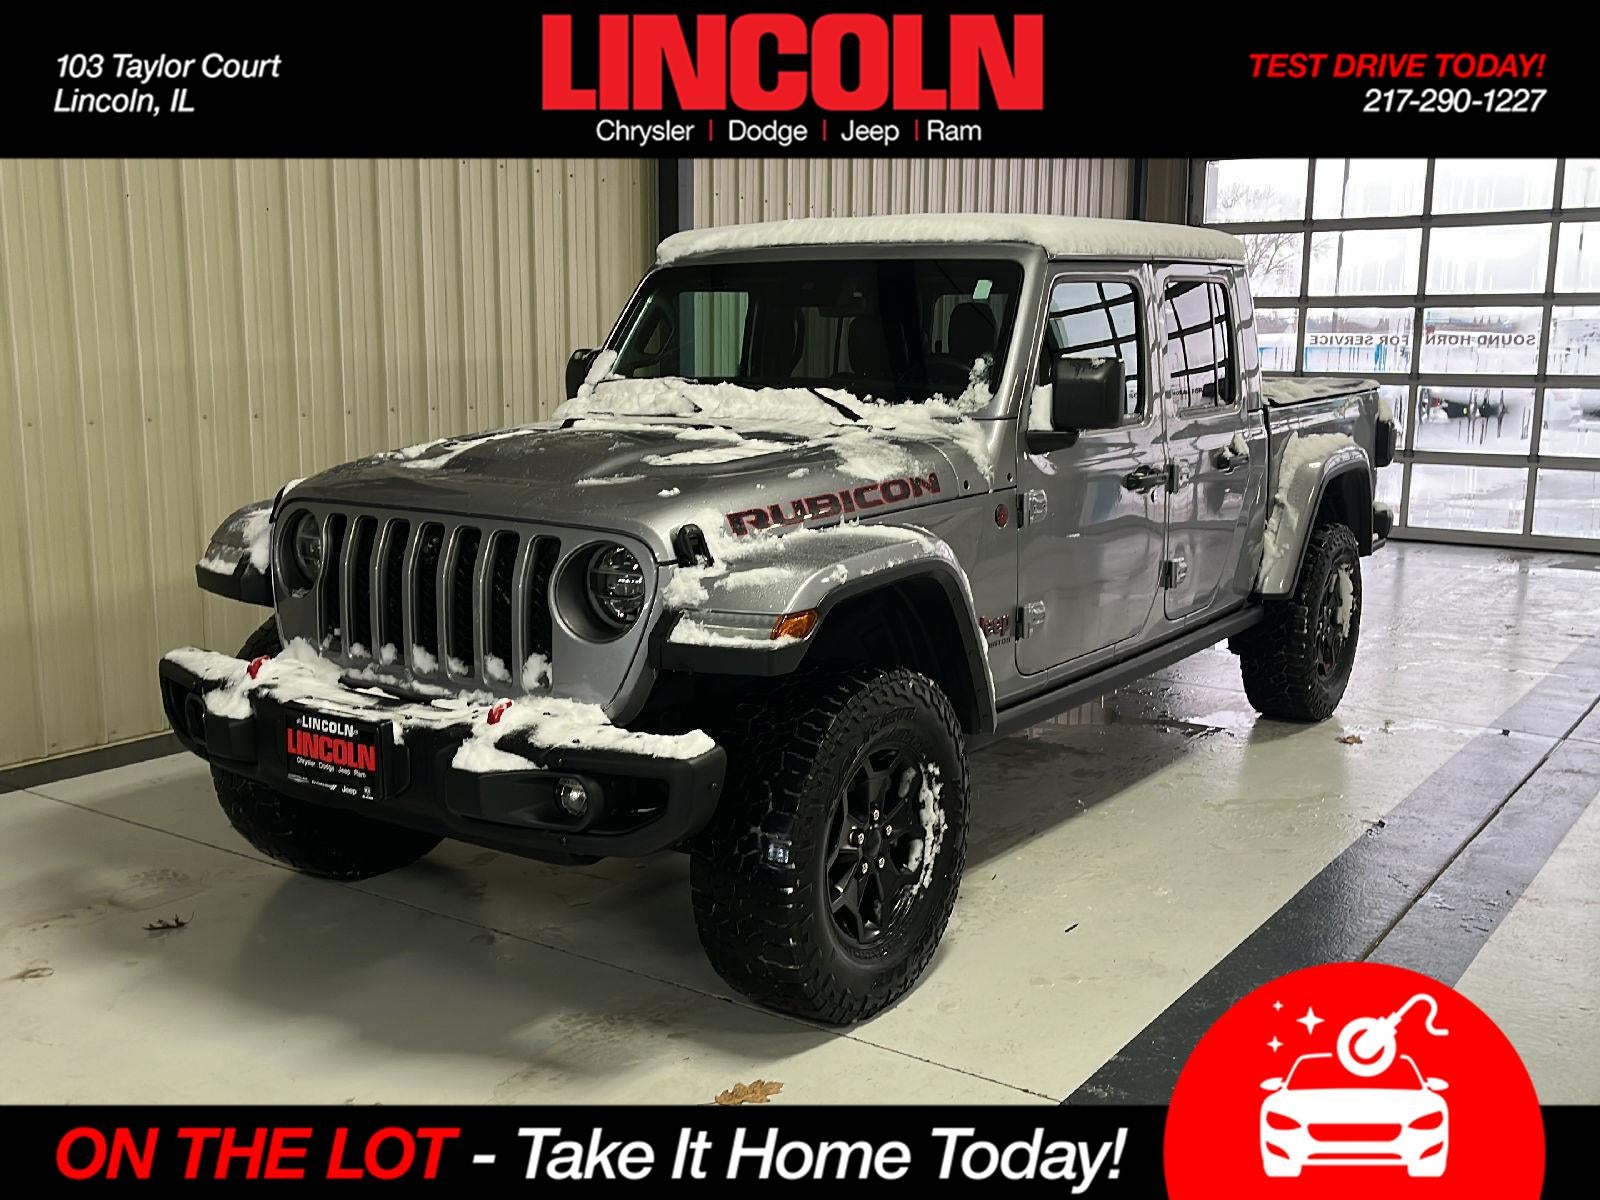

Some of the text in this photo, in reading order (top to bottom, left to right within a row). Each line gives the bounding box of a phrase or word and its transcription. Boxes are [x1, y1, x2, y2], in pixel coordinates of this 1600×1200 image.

[725, 472, 941, 536] RUBICON
[979, 612, 1009, 638] Jeep
[302, 715, 354, 737] LINCOLN
[287, 728, 376, 771] LINCOLN
